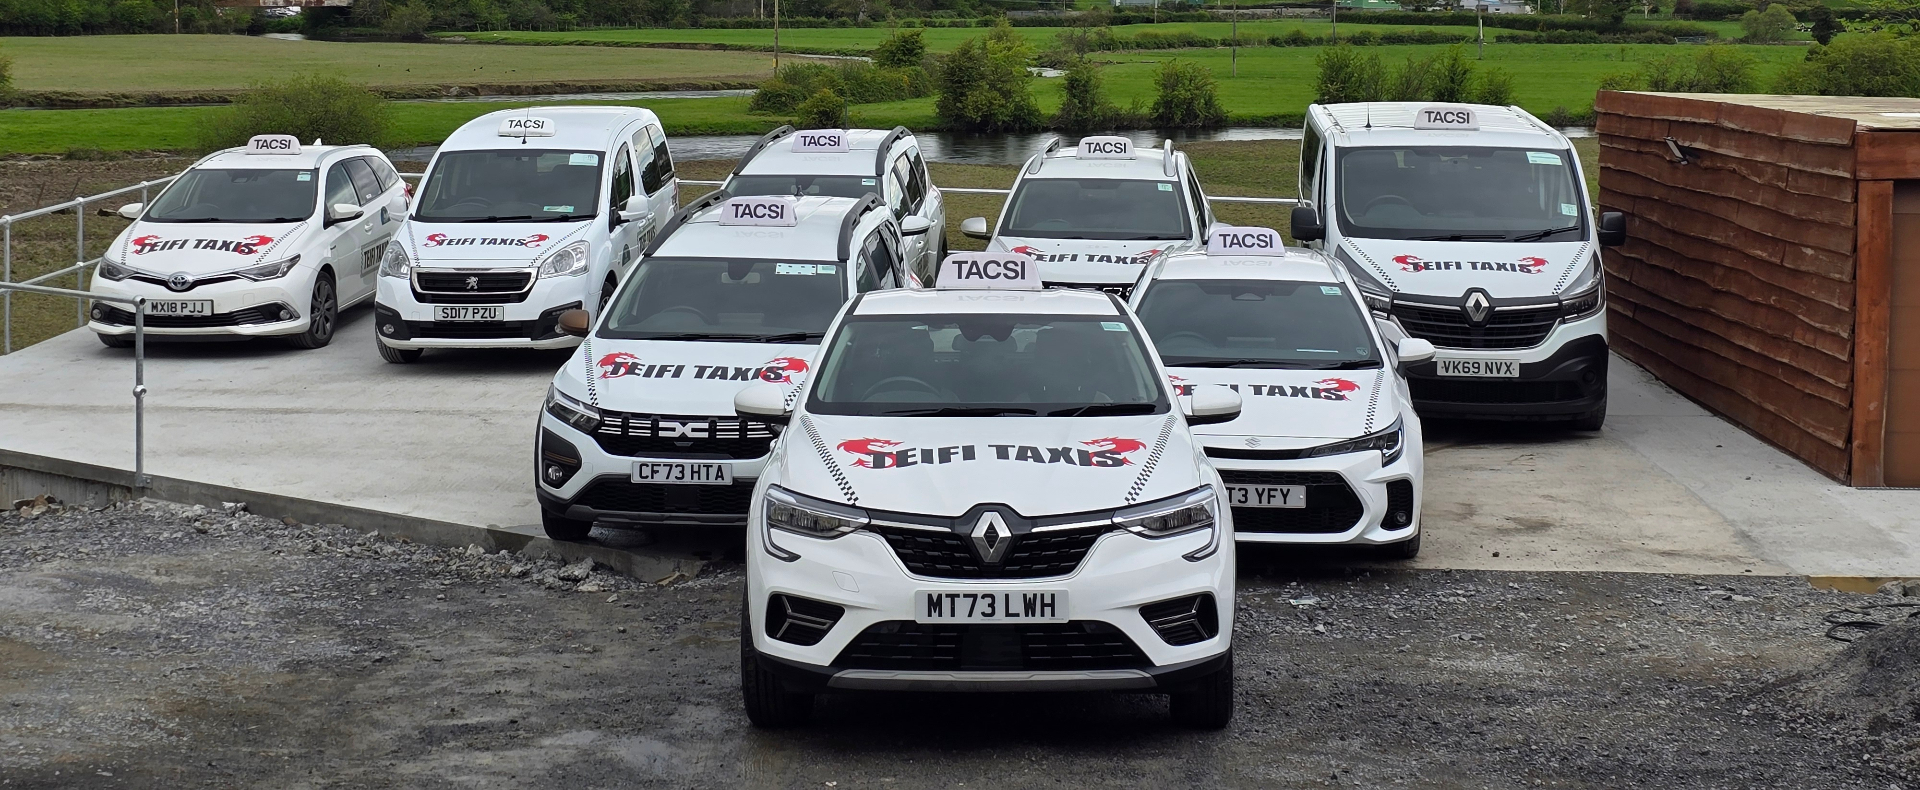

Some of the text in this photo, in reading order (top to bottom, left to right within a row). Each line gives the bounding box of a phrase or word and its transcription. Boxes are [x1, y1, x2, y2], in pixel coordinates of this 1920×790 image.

[508, 119, 545, 129] TACSI
[1424, 110, 1470, 124] TACSI
[253, 139, 292, 150] TACSI
[800, 135, 841, 147] TACSI
[1084, 142, 1127, 154] TACSI
[731, 203, 785, 220] TACSI
[138, 239, 254, 255] TEIFI TAXIS
[438, 238, 527, 247] TEIFI TAXIS
[1218, 233, 1274, 249] TACSI
[952, 260, 1026, 280] TACSI
[1409, 261, 1533, 274] TEIFI TAXIS
[151, 301, 204, 313] MX18 PJJ
[442, 307, 497, 319] SD17 PZU
[609, 361, 785, 382] TEIFI TAXIS
[1443, 360, 1513, 375] VK69 NVX
[1248, 384, 1344, 401] TAXIS
[868, 444, 1125, 469] TEIFI TAXIS
[638, 463, 725, 481] CF73 HTA
[1255, 487, 1291, 505] YFY
[927, 593, 1056, 618] MT73 LWH
